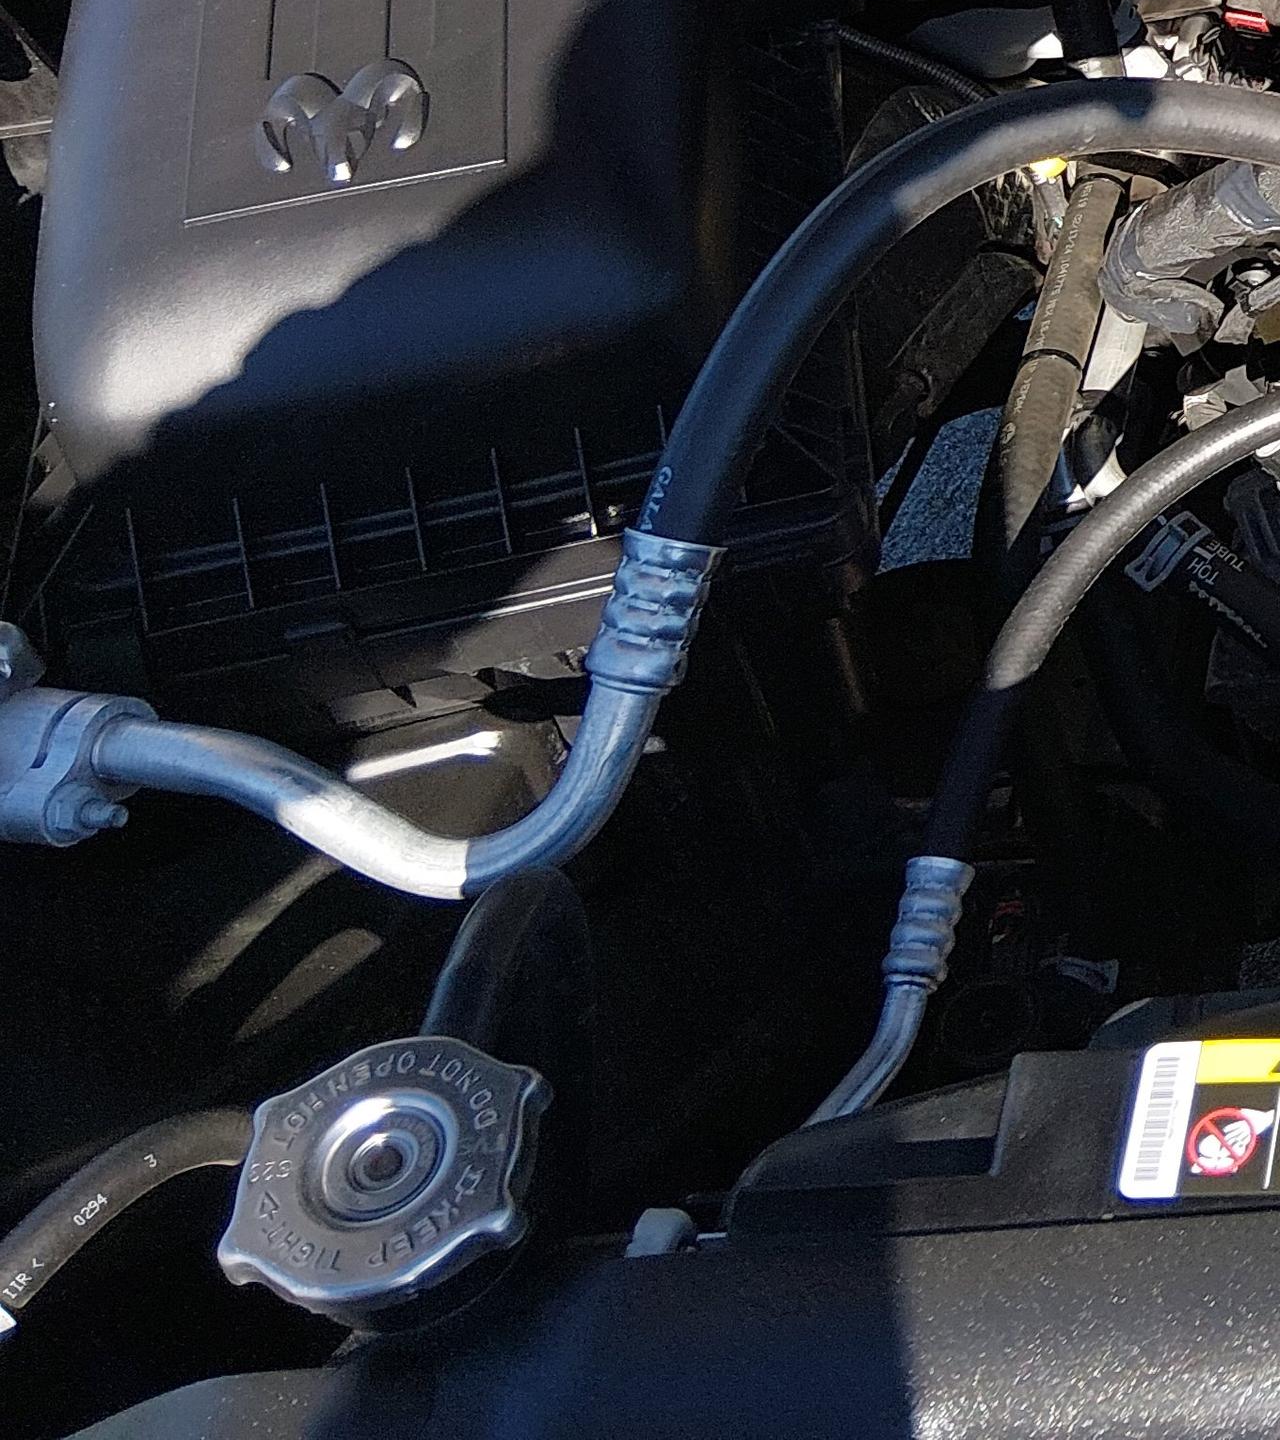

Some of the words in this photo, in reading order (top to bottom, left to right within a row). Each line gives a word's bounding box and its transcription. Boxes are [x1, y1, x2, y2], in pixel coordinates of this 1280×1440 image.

[1205, 540, 1244, 572] TUBE
[72, 1193, 109, 1227] 0294
[368, 1198, 460, 1267] KEEP
